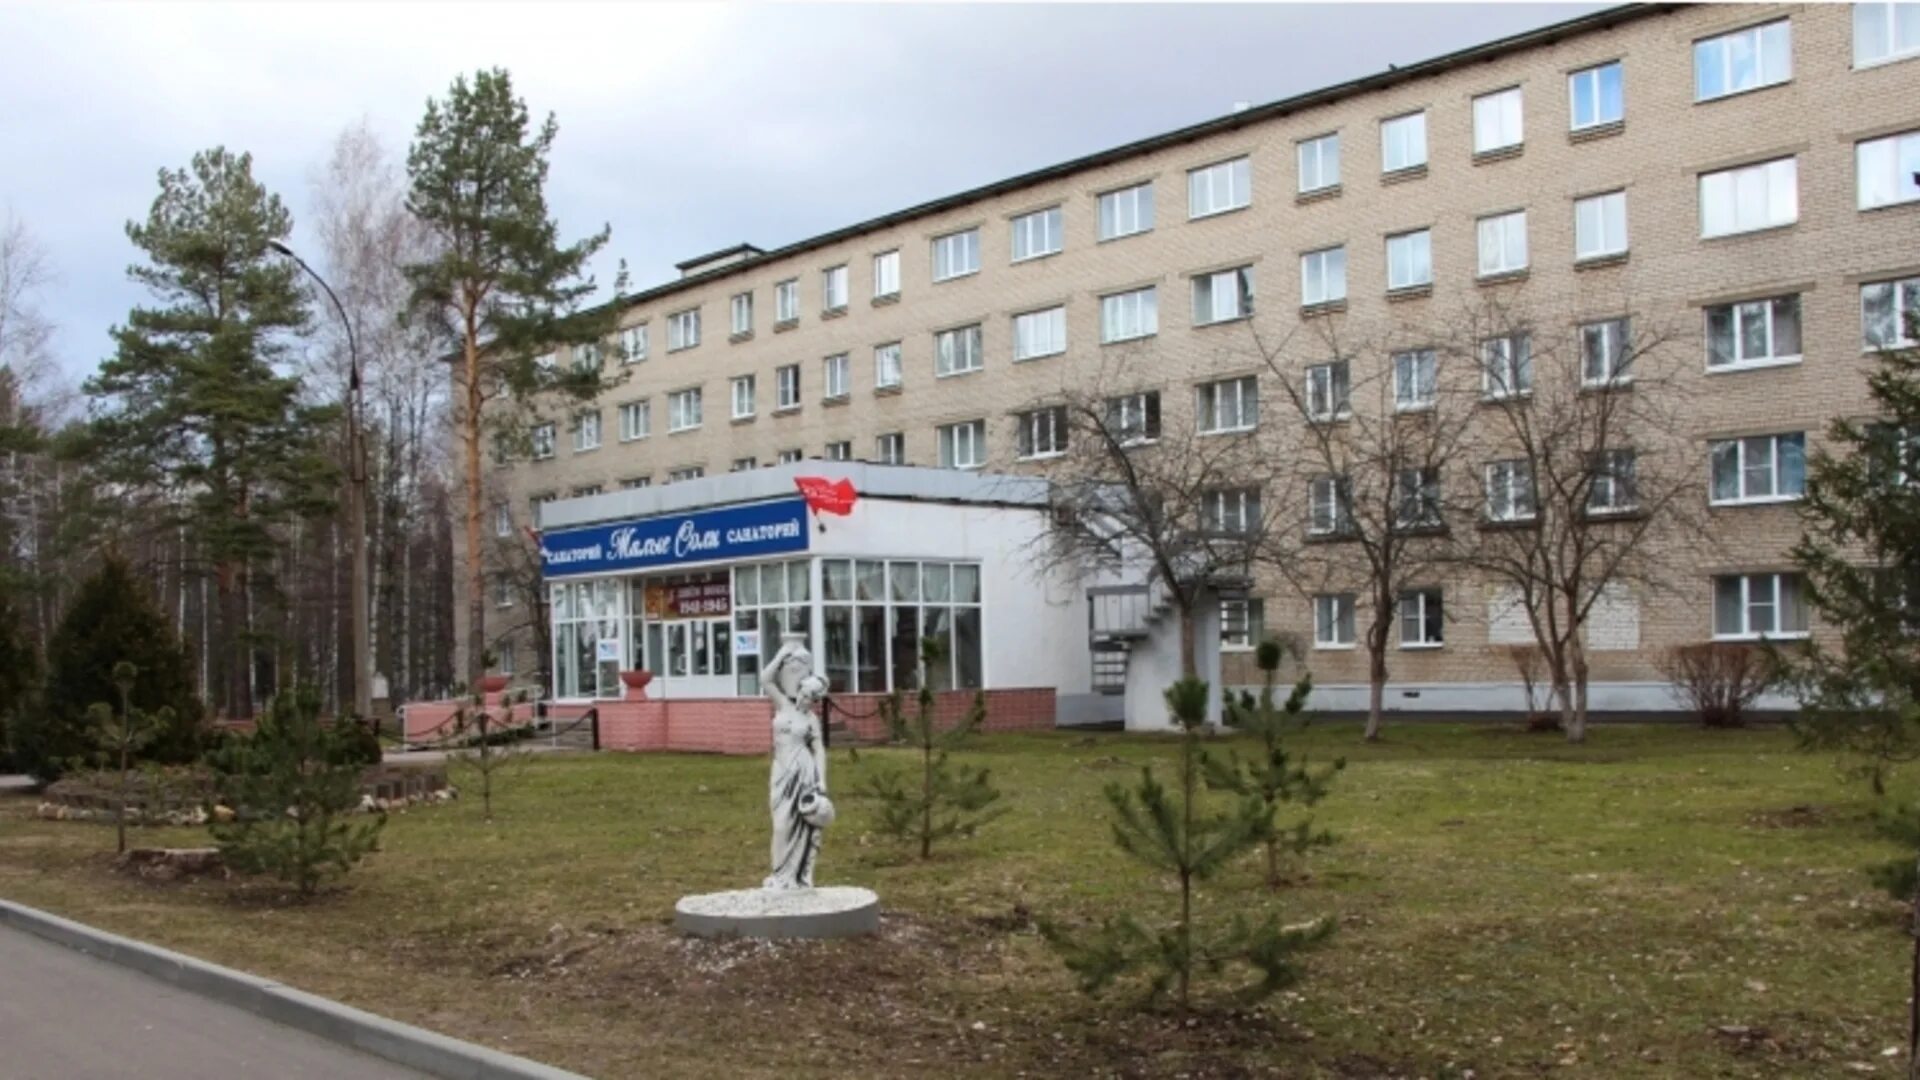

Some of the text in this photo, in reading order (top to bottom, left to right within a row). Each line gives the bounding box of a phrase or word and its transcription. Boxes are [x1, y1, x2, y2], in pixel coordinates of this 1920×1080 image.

[547, 519, 799, 564] САНАТОРИЙ Малые Соли САНАТОРИЙ
